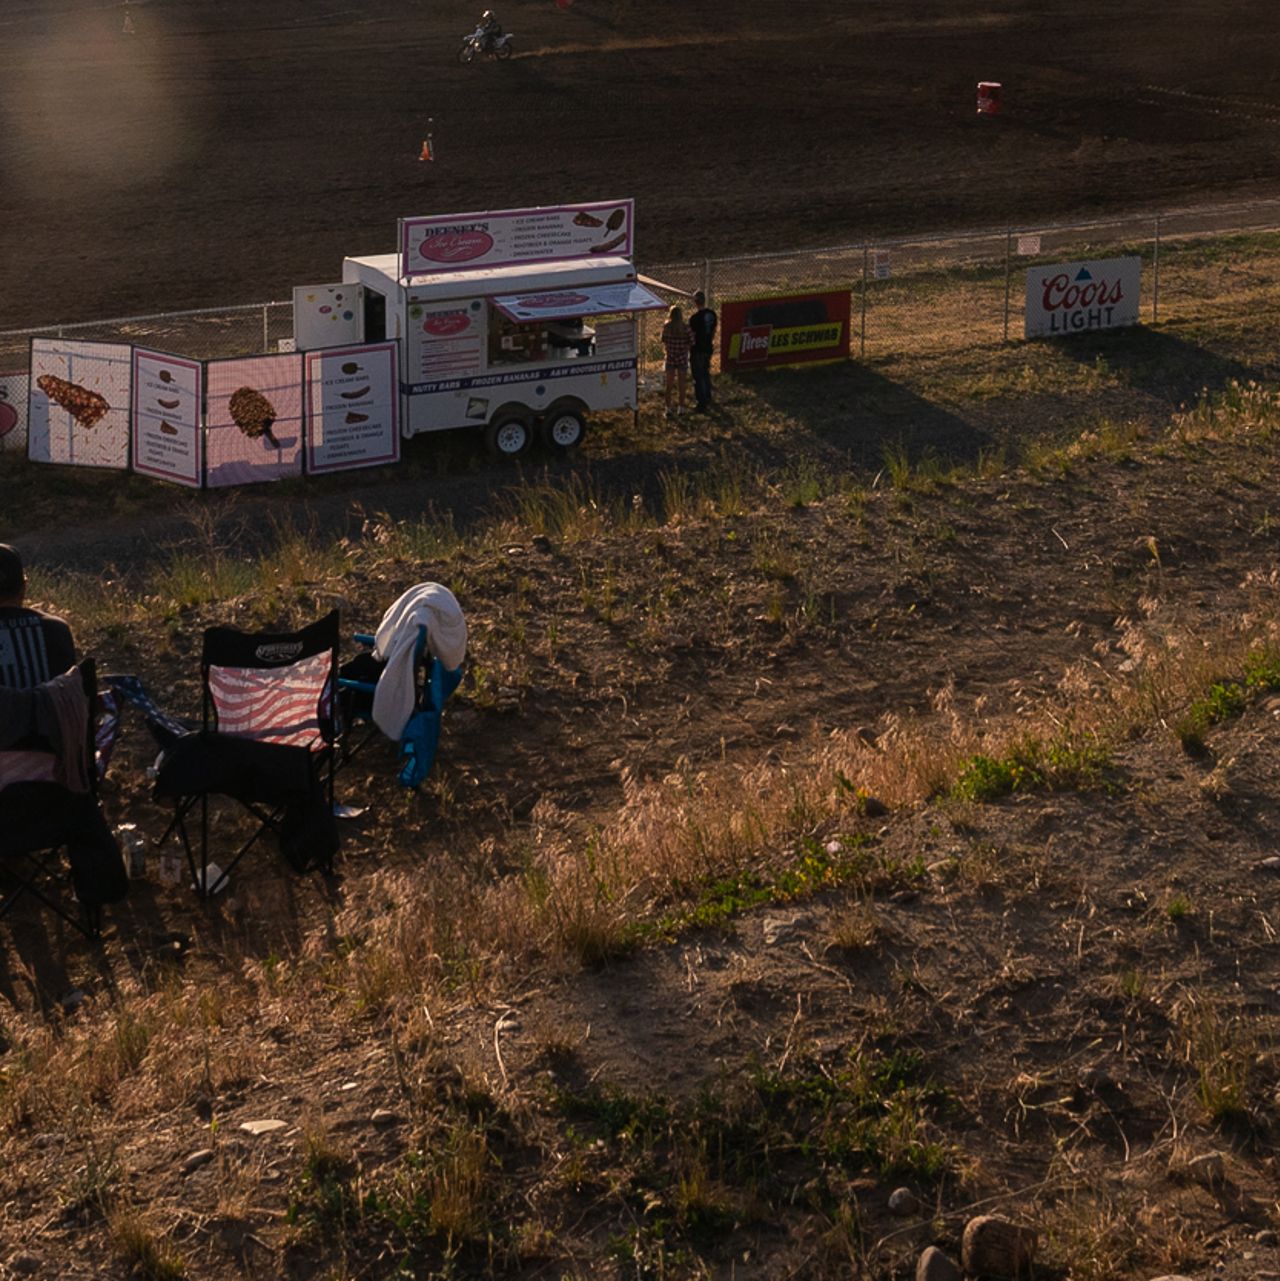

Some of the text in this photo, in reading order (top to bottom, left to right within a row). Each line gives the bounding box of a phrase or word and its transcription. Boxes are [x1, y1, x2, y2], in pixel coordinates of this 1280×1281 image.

[425, 222, 489, 237] DEENEY'S
[1042, 274, 1124, 312] Coors
[1051, 307, 1114, 332] LIGHT
[741, 328, 838, 353] Tires LES SCHWAB
[412, 383, 437, 393] NUTTY
[438, 380, 460, 390] BARS
[471, 376, 502, 386] FROZEN
